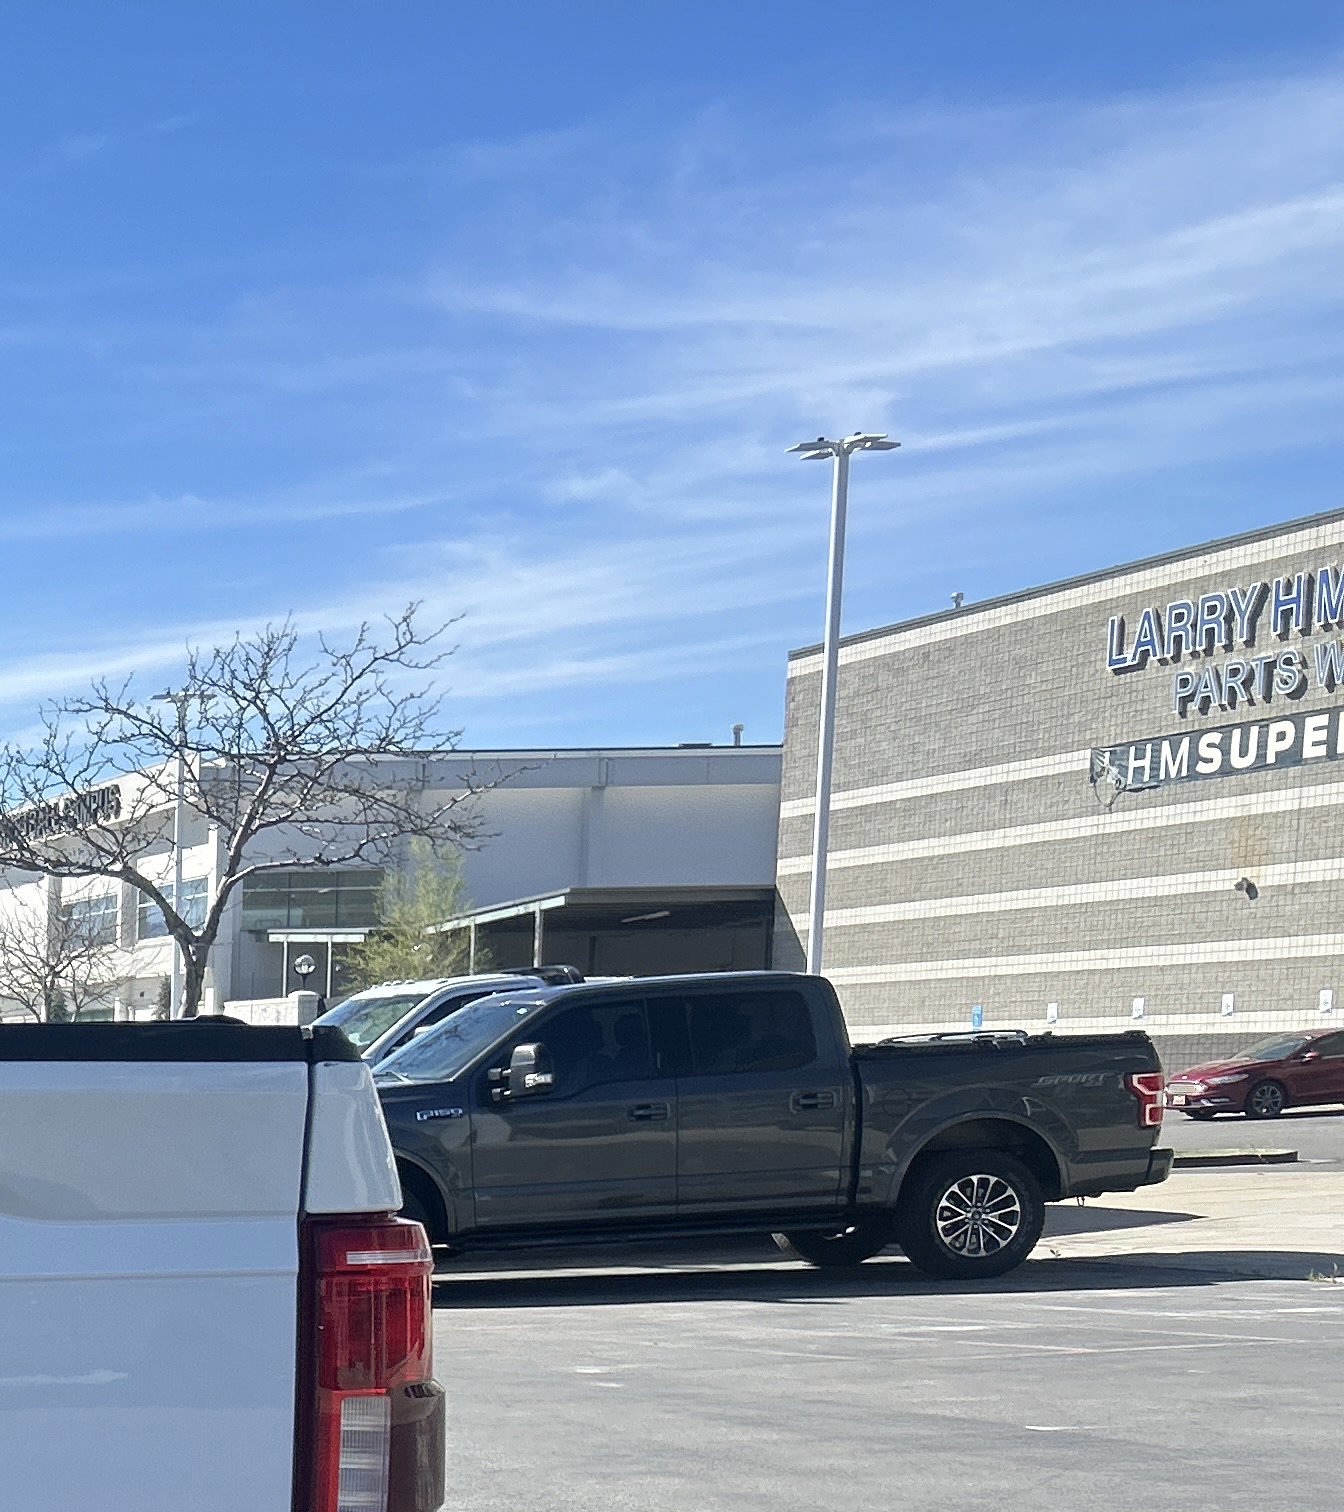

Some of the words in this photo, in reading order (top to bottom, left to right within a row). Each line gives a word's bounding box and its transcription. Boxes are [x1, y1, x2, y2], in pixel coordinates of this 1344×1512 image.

[1106, 581, 1262, 671] LARRY
[1270, 571, 1309, 637] H
[1172, 648, 1300, 714] PARTS
